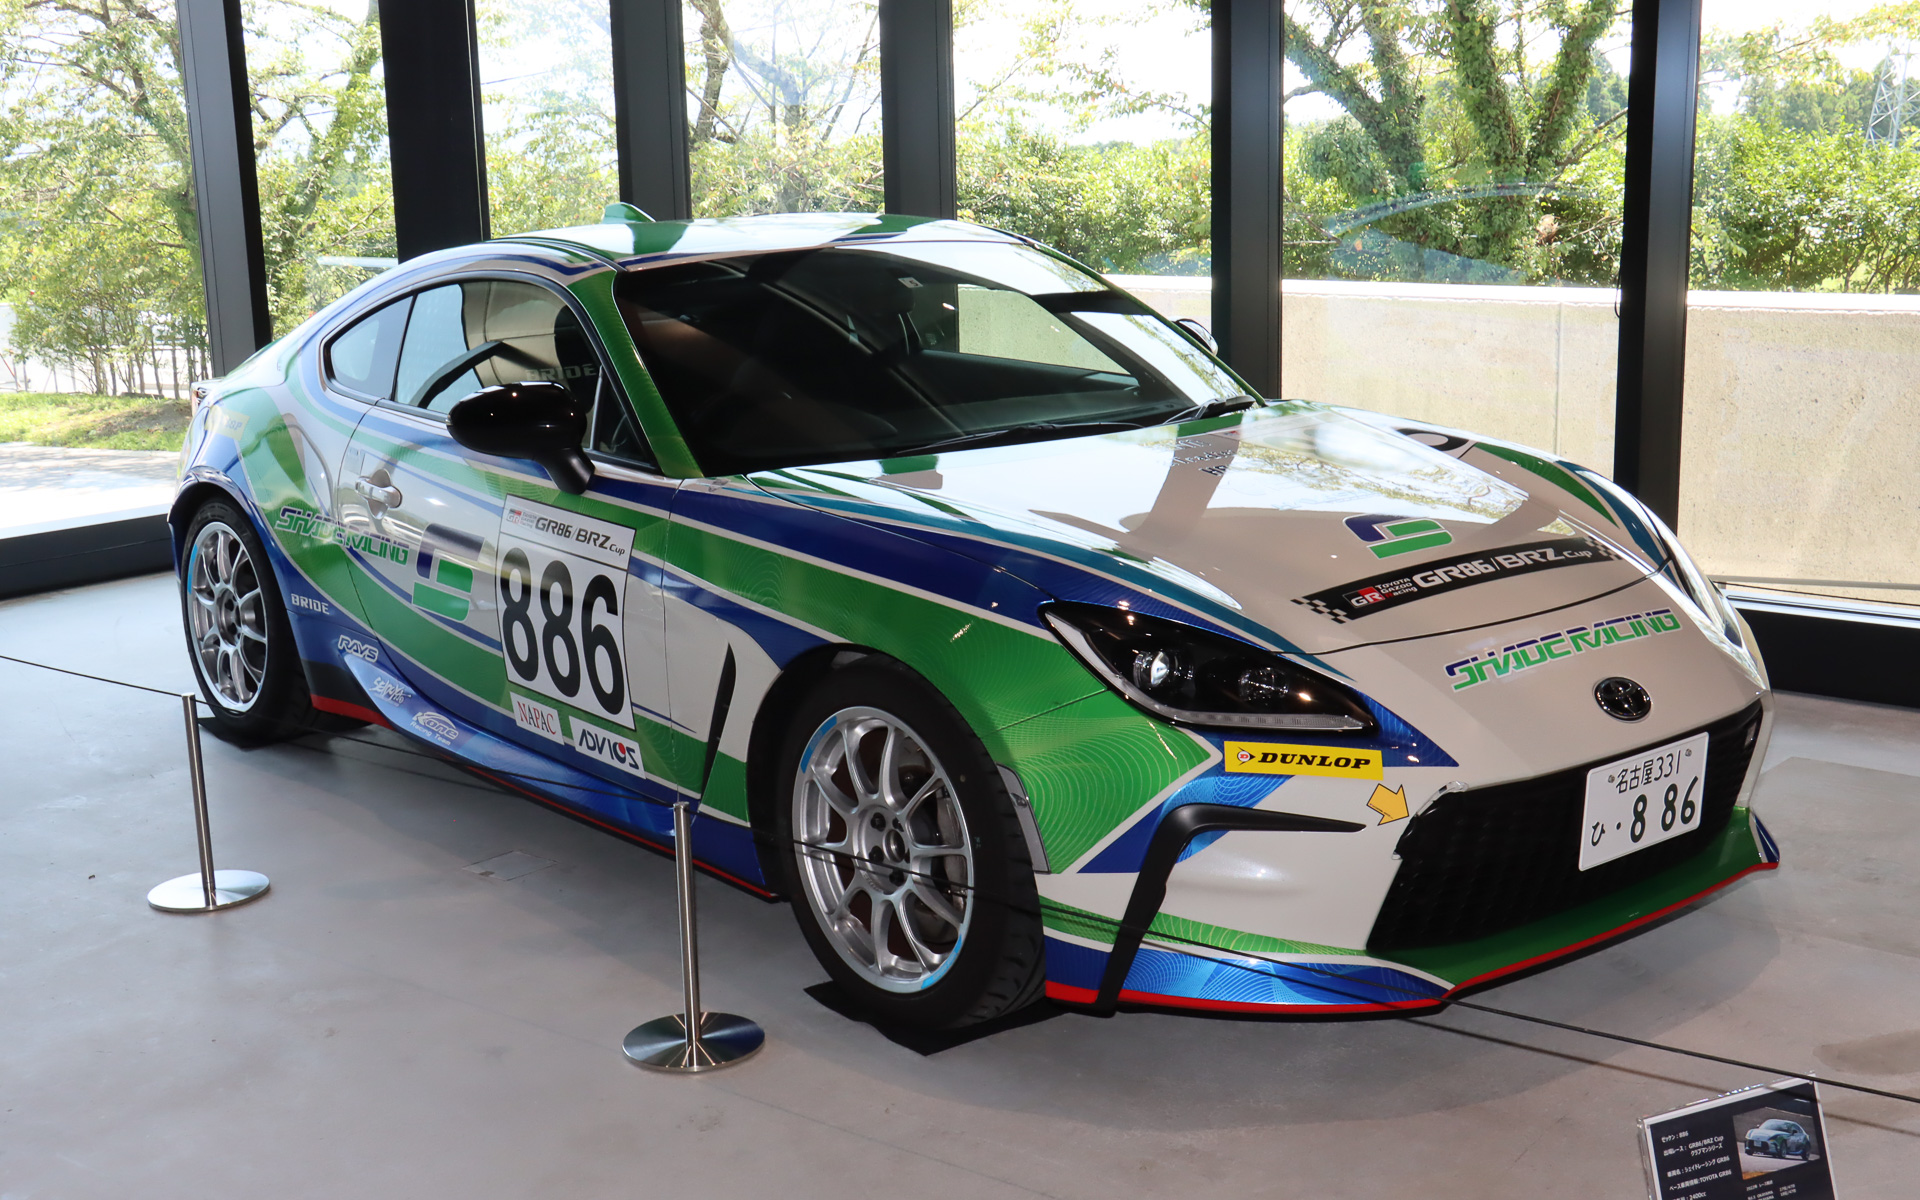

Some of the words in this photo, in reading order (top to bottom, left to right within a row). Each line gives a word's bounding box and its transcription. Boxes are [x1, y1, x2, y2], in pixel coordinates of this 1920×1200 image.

[525, 363, 597, 381] BRIDE
[609, 543, 626, 556] Cup
[1562, 548, 1593, 560] Cup
[1375, 577, 1411, 589] TOYOTA
[1381, 582, 1413, 594] GAZOO
[291, 593, 331, 616] BRIDE
[500, 547, 625, 715] 886
[338, 635, 379, 663] RAYS
[1444, 631, 1573, 692] SHADE
[1565, 607, 1682, 652] RACING
[517, 701, 557, 735] NAPAC
[410, 721, 432, 737] Racing
[434, 733, 451, 746] Team
[1258, 752, 1371, 769] DUNLOP
